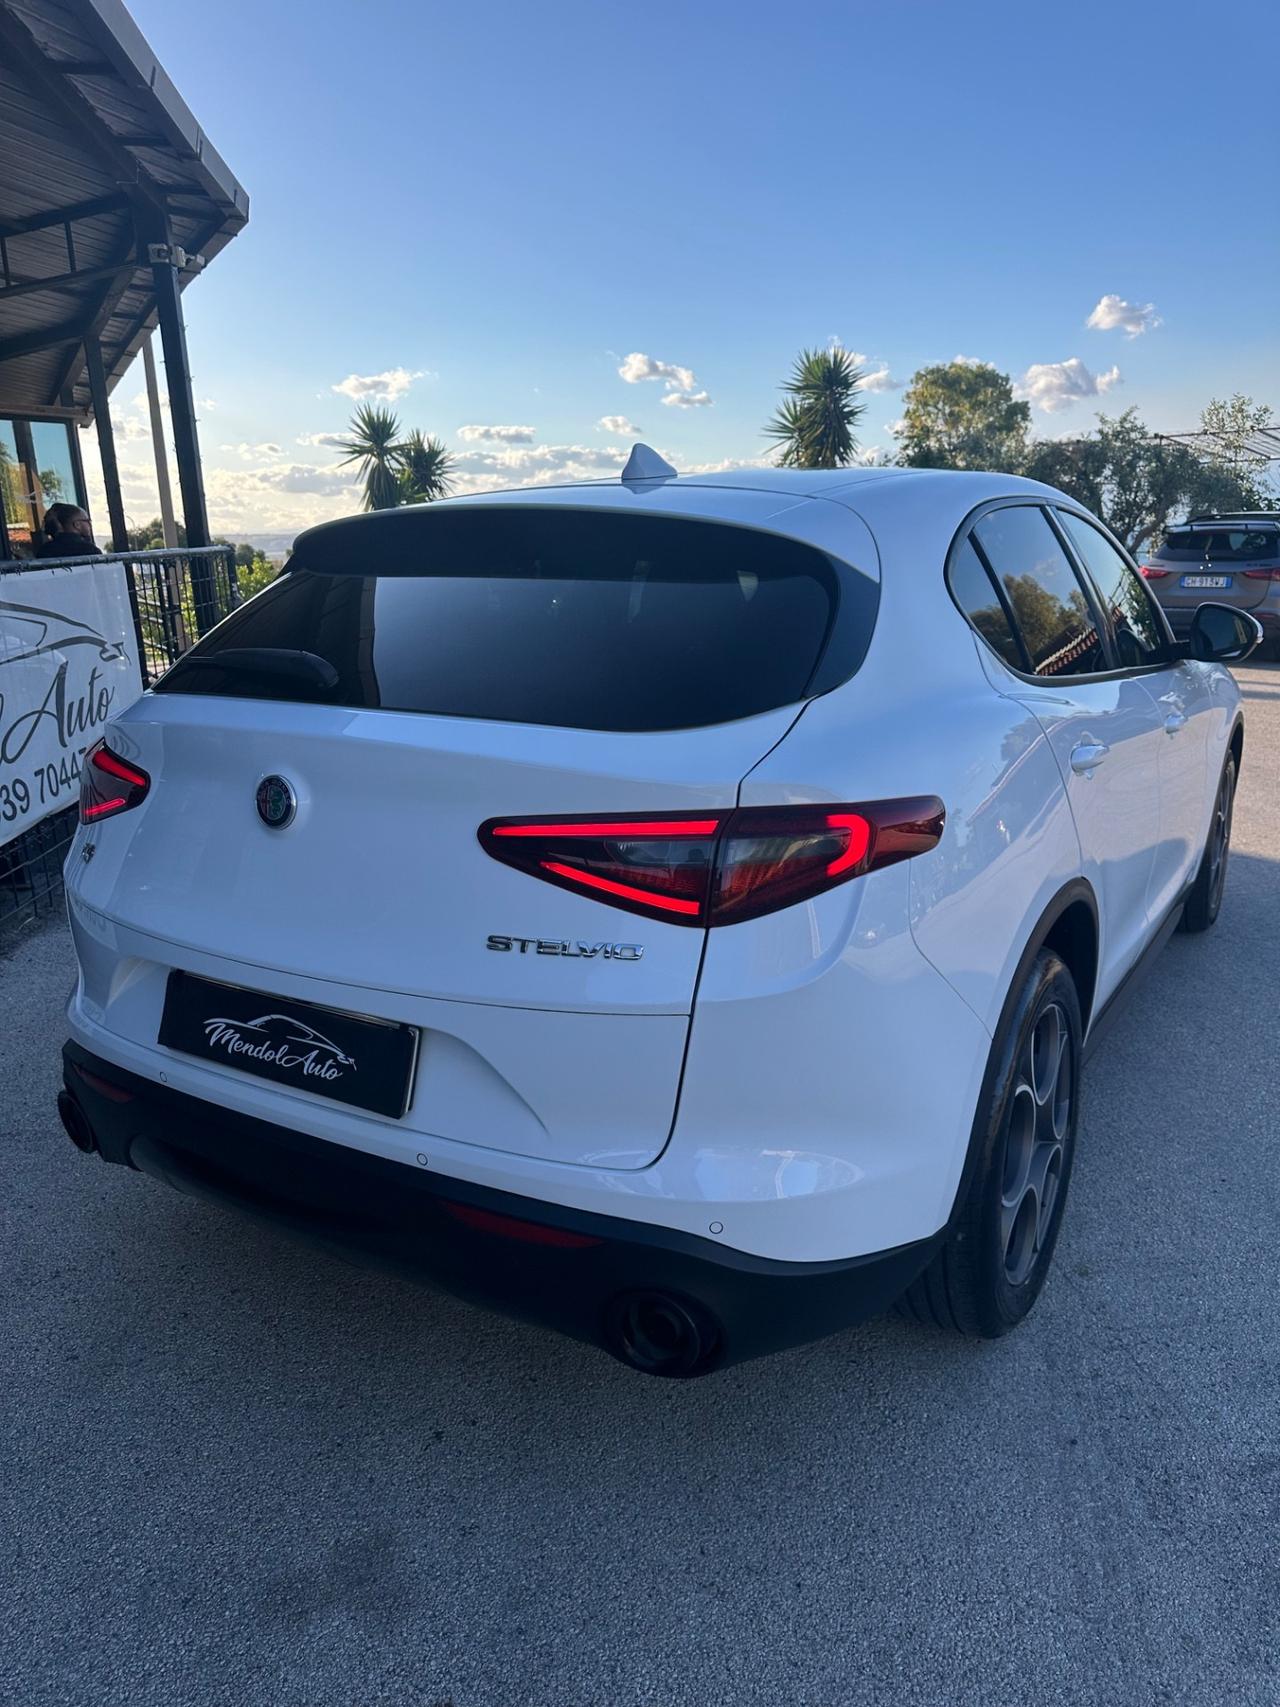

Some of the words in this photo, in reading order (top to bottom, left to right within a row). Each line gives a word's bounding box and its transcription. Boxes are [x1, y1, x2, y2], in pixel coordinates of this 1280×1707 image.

[0, 660, 115, 765] Auto
[0, 778, 30, 821] 39
[486, 934, 645, 961] STELVIO
[204, 1022, 344, 1081] MendolAuto
